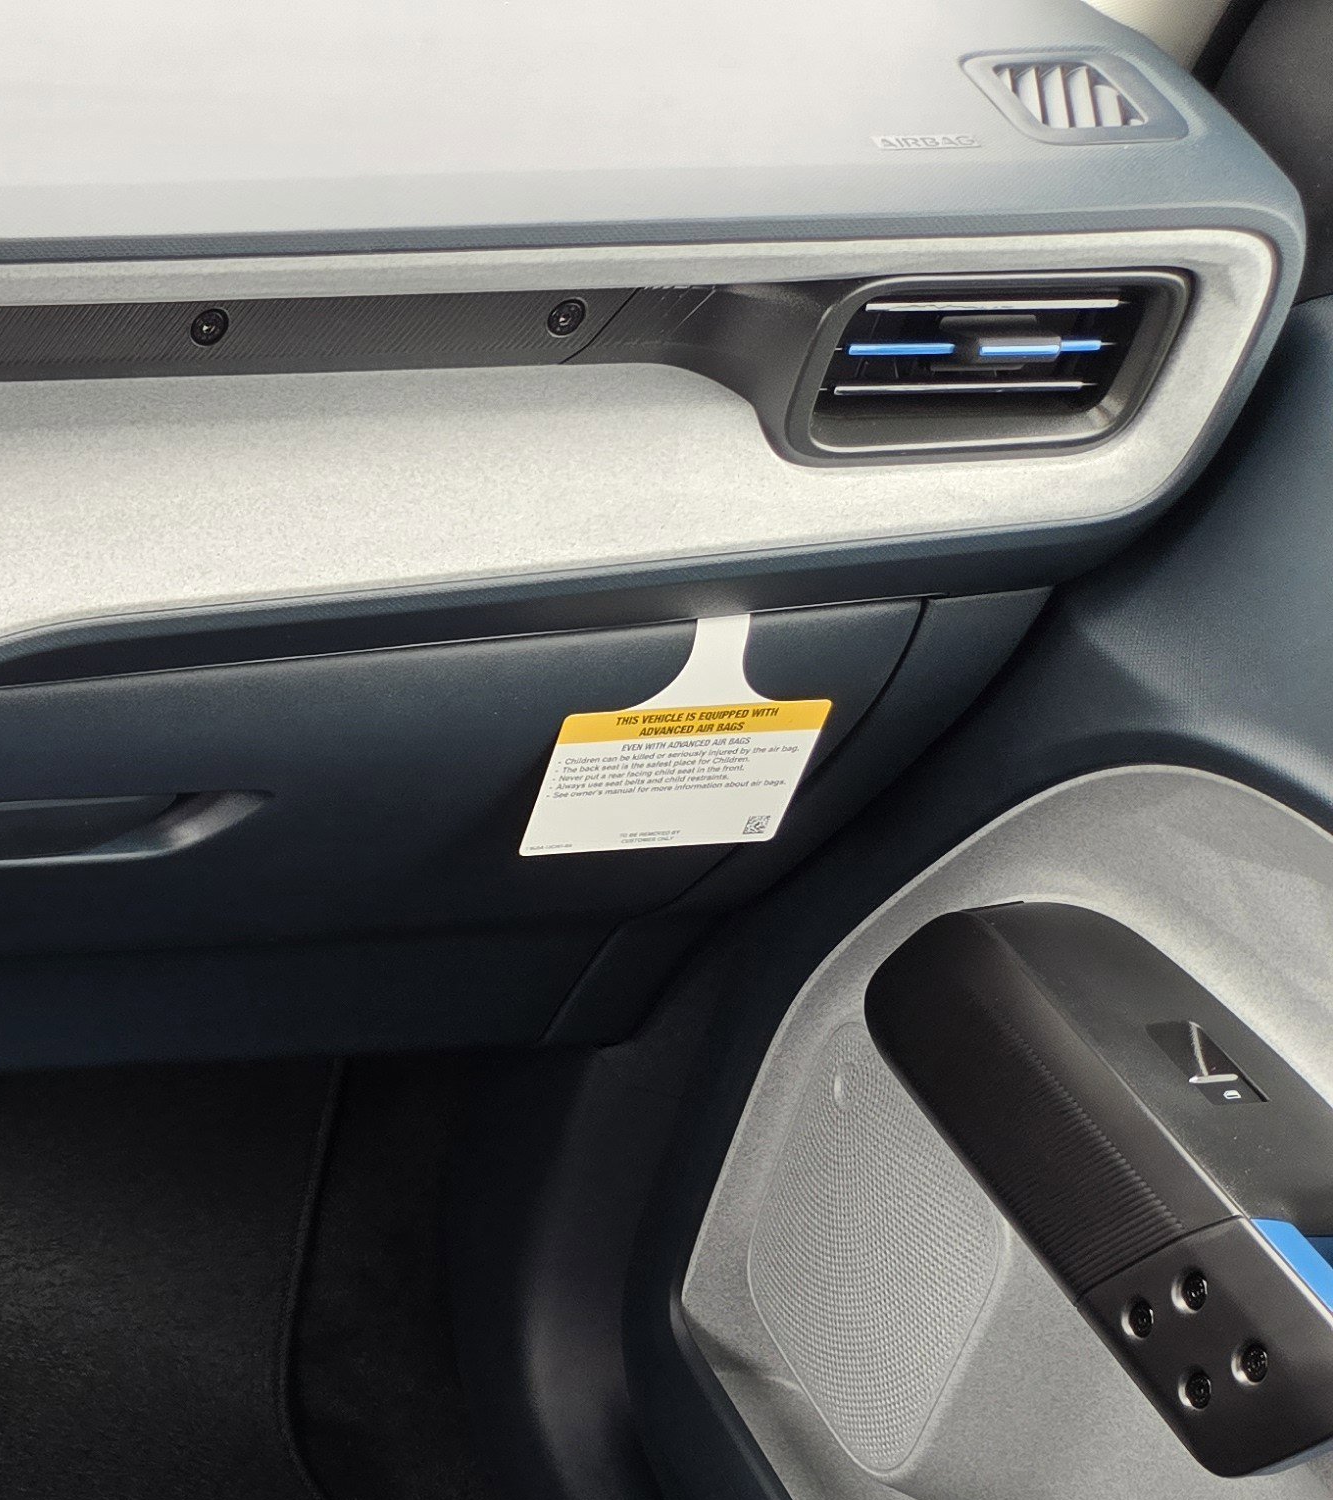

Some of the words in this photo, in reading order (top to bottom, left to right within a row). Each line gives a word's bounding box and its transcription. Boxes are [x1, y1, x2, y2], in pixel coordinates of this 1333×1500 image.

[879, 135, 976, 149] AIRBAG
[616, 715, 639, 726] THIS
[642, 713, 684, 724] VEHICLE
[685, 712, 696, 722] IS
[698, 709, 749, 721] EQUIPPED
[752, 707, 779, 718] WITH
[639, 725, 694, 737] ADVANCED
[696, 724, 714, 733] AIR
[716, 722, 745, 732] BAGS
[621, 743, 643, 752] EVEN
[645, 742, 666, 750] WITH
[667, 739, 711, 749] ADVANCED
[712, 738, 727, 746] AIR
[729, 737, 751, 745] BAGS
[564, 757, 600, 765] Children
[668, 750, 706, 758] seriously
[708, 747, 738, 756] injured
[740, 748, 751, 756] by
[579, 764, 600, 772] back
[646, 760, 671, 768] safest
[626, 770, 653, 778] facing
[655, 768, 676, 776] child
[556, 782, 585, 790] Always
[570, 789, 603, 797] owner's
[674, 782, 723, 790] information
